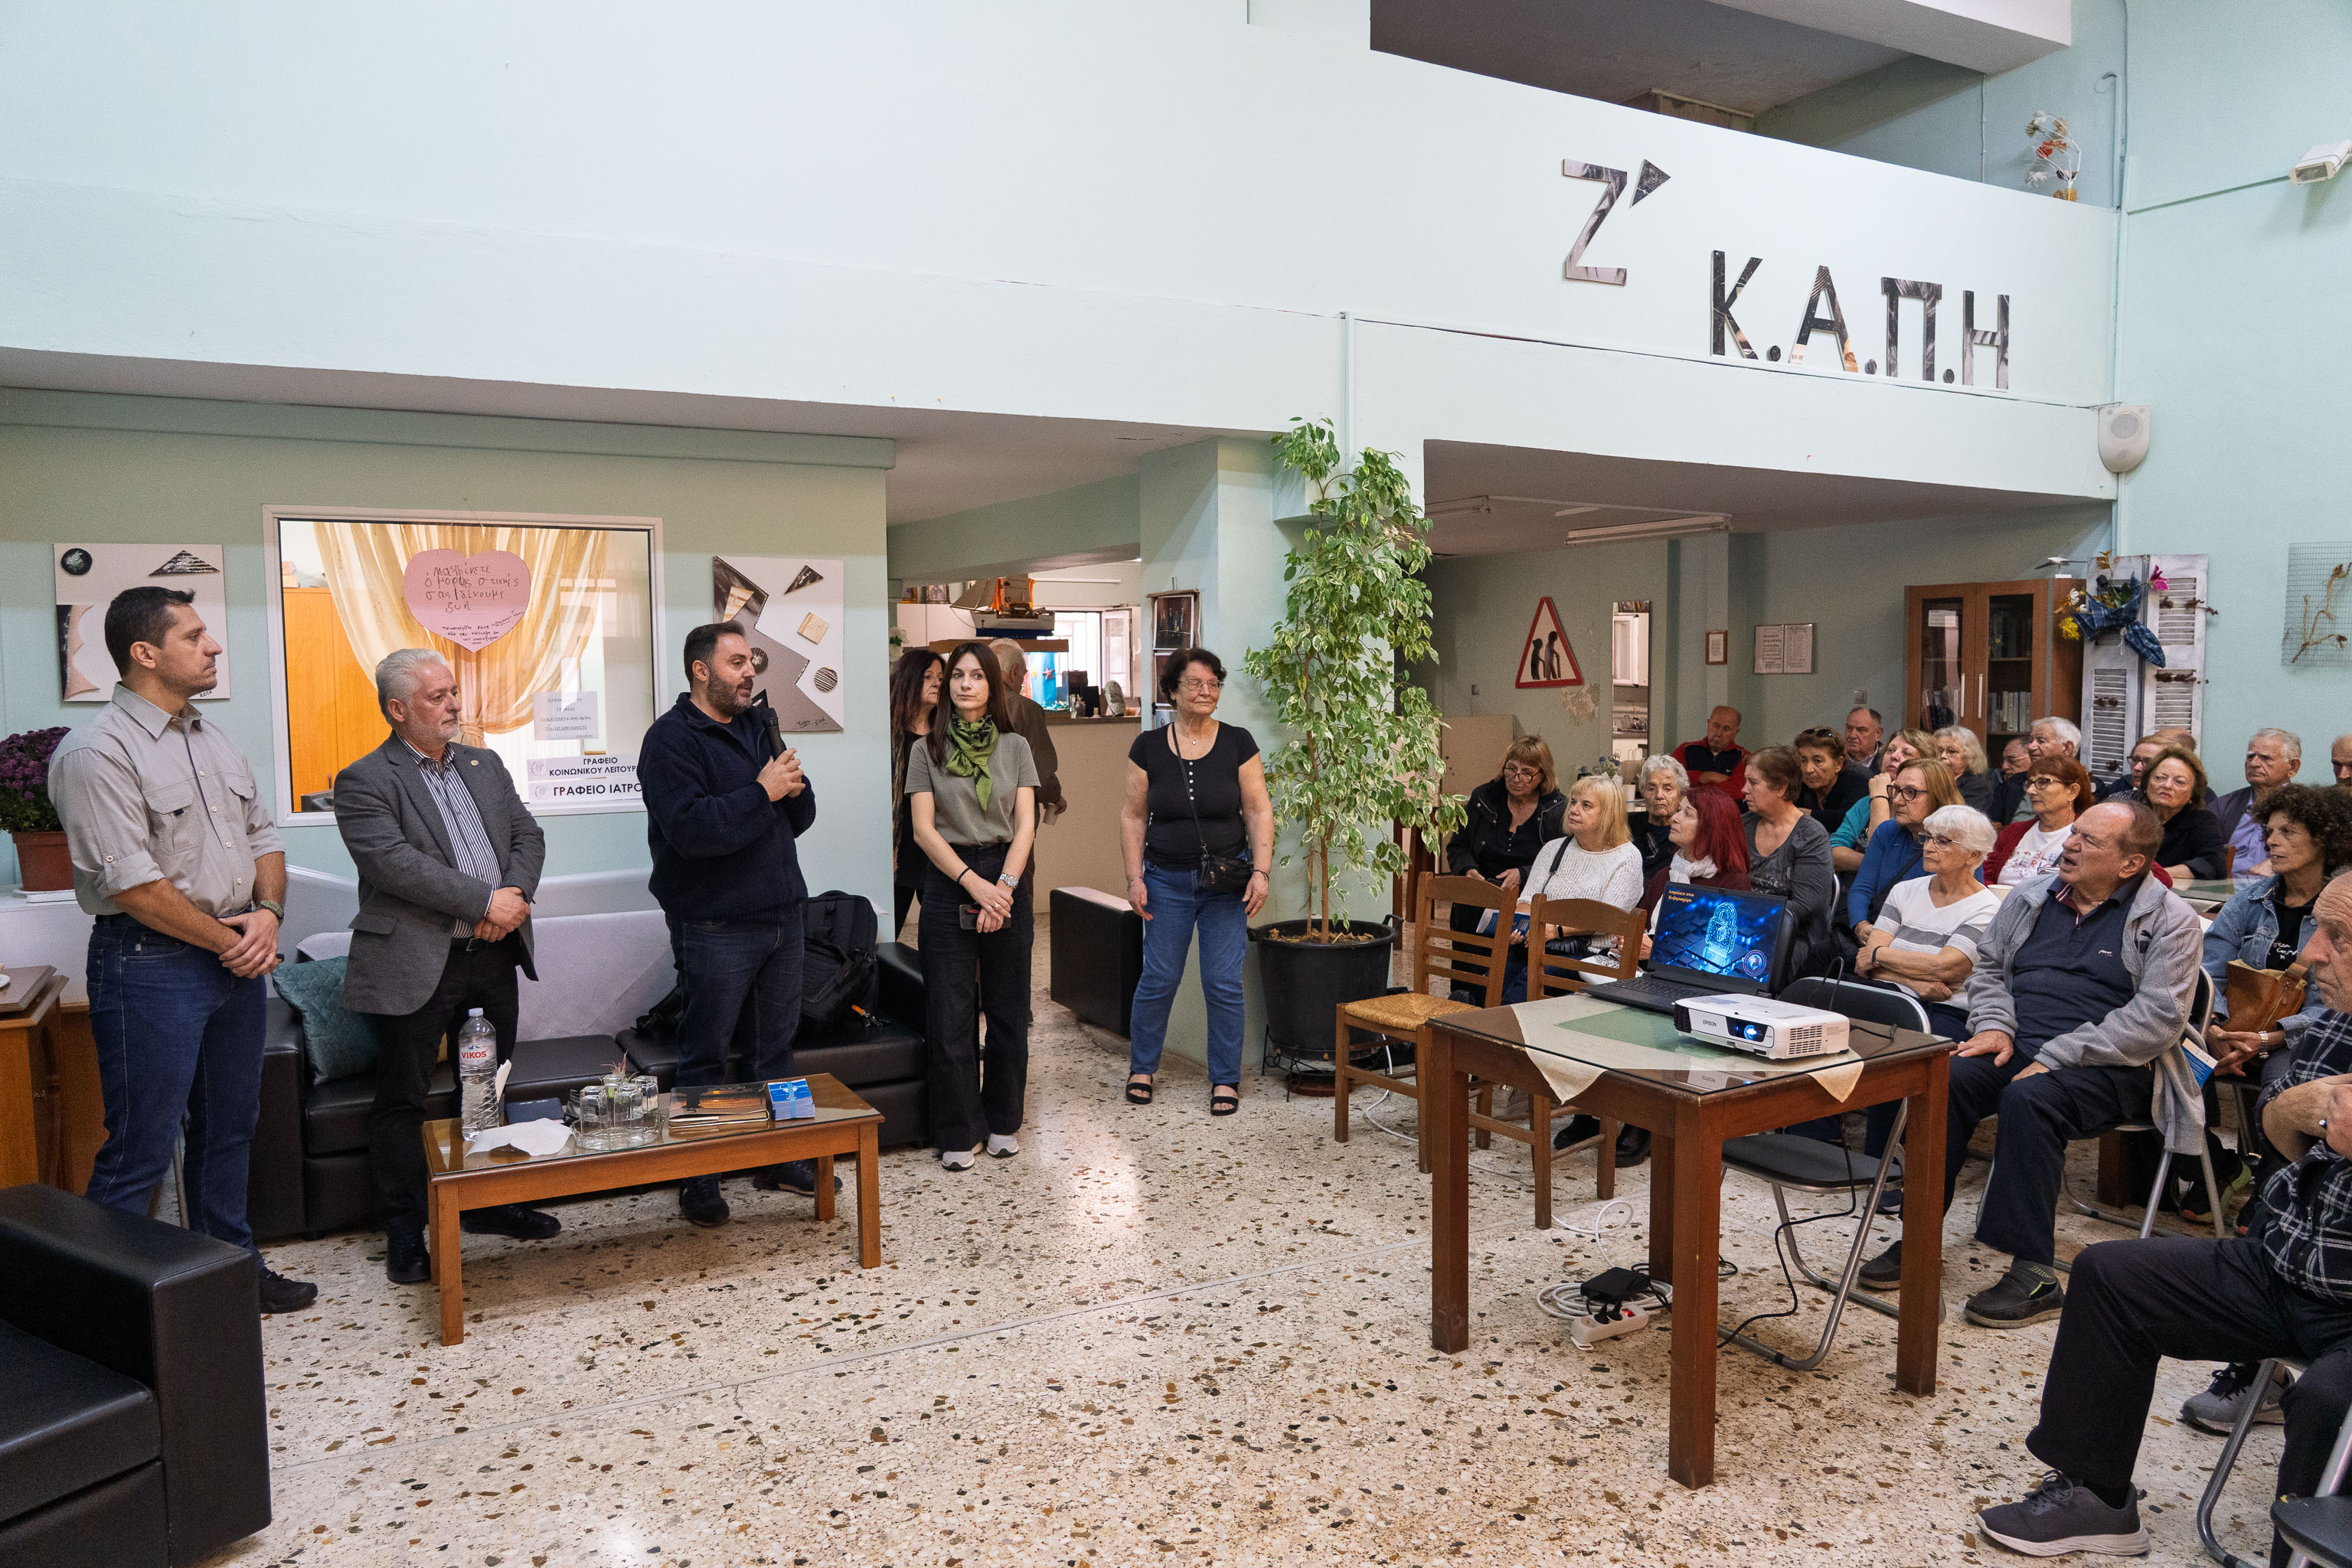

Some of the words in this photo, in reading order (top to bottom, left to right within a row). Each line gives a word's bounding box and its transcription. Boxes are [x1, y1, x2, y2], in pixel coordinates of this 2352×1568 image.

[550, 767, 602, 776] ΚΟΙΝΩΝΙΚΟΥ
[554, 785, 606, 796] ΓΡΑΦΕΙΟ
[461, 1050, 488, 1059] VIKOS
